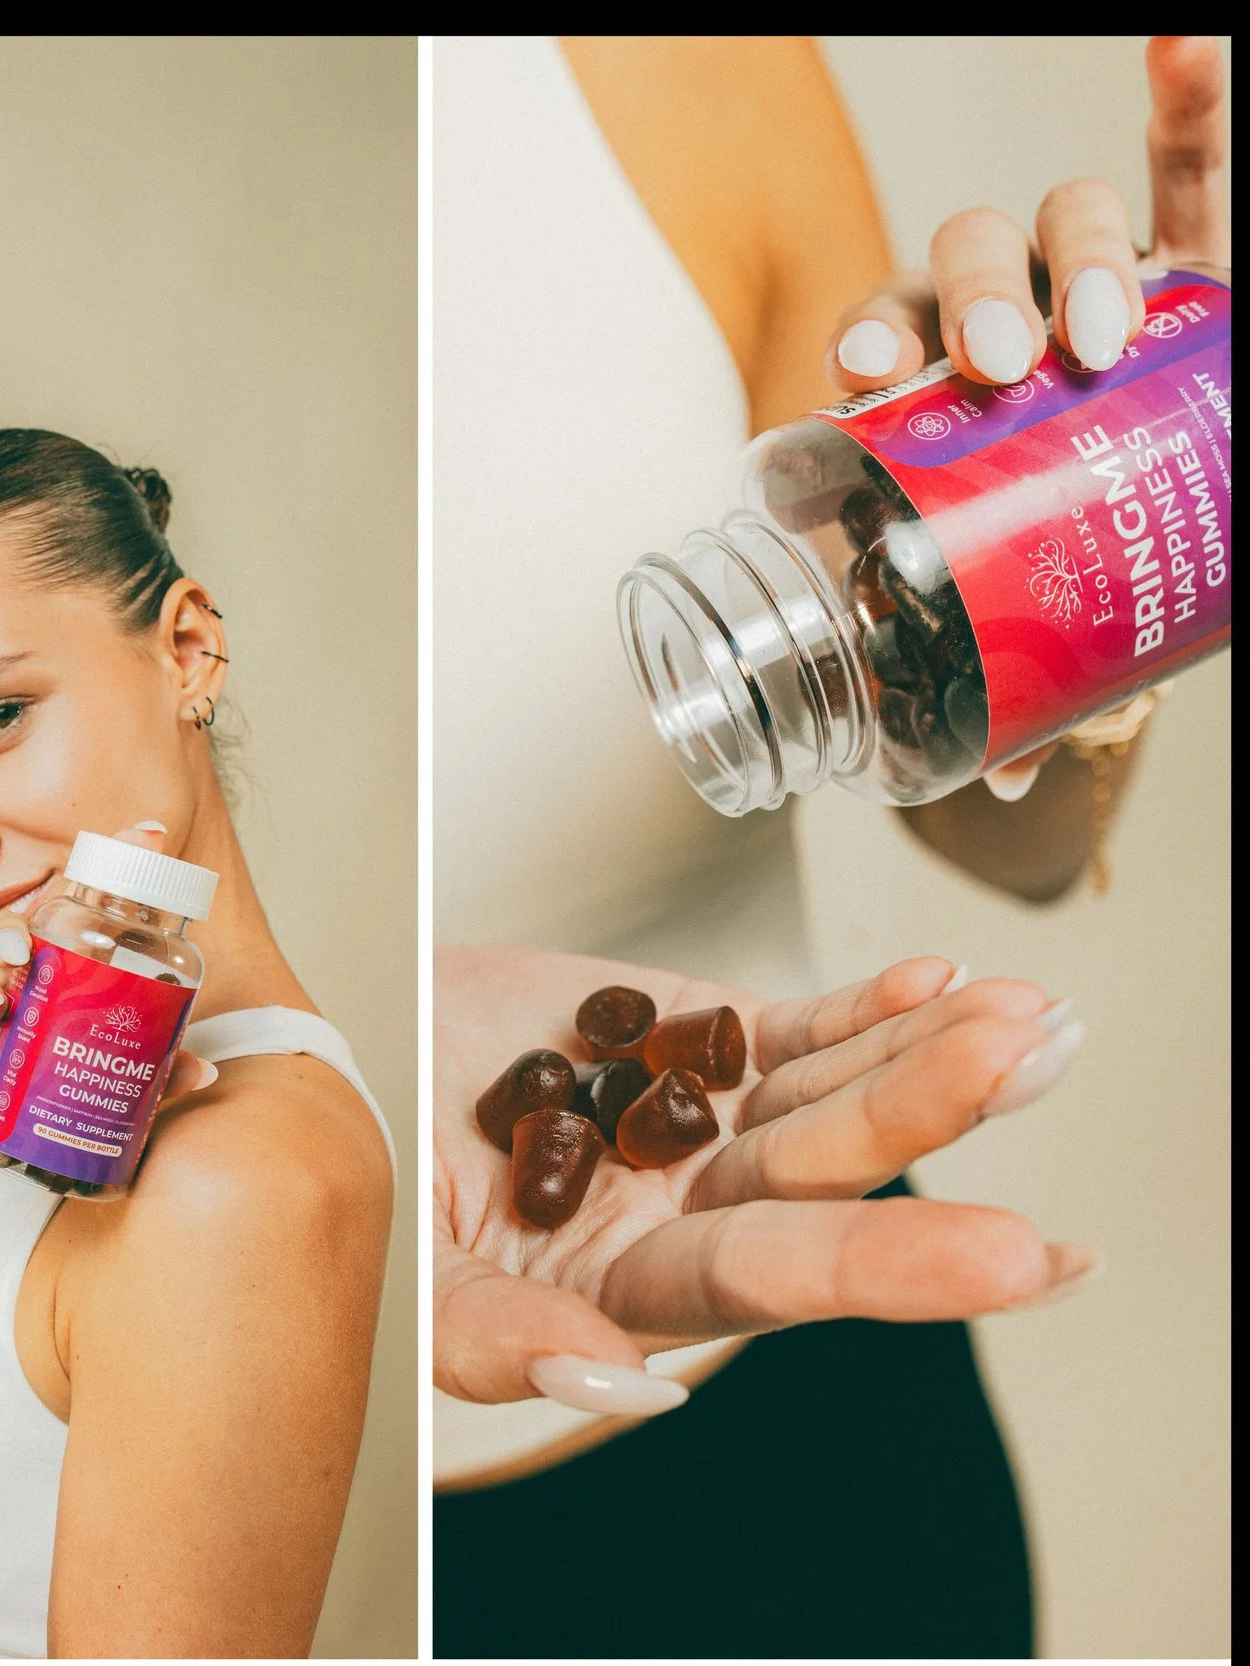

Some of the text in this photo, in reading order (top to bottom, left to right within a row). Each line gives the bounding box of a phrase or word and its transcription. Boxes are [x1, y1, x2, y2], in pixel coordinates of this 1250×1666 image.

[1032, 370, 1054, 389] Vega
[947, 404, 970, 424] Inner
[961, 398, 982, 418] Calm
[1178, 387, 1213, 439] ELDERBERRY
[1211, 445, 1226, 470] MOSS
[1123, 427, 1196, 623] HAPPINESS
[1168, 431, 1226, 587] GUMMIES
[1070, 425, 1164, 657] BRINGME
[1071, 505, 1113, 626] EcoLuxe
[90, 1024, 141, 1049] EcoLuxe
[52, 1036, 155, 1081] BRINGME
[54, 1061, 142, 1098] HAPPINESS
[59, 1084, 129, 1114] GUMMIES
[29, 1105, 134, 1142] DIETARY SUPPLEMENT
[37, 1126, 119, 1154] 90 GUMMIES PER BOTTLE
